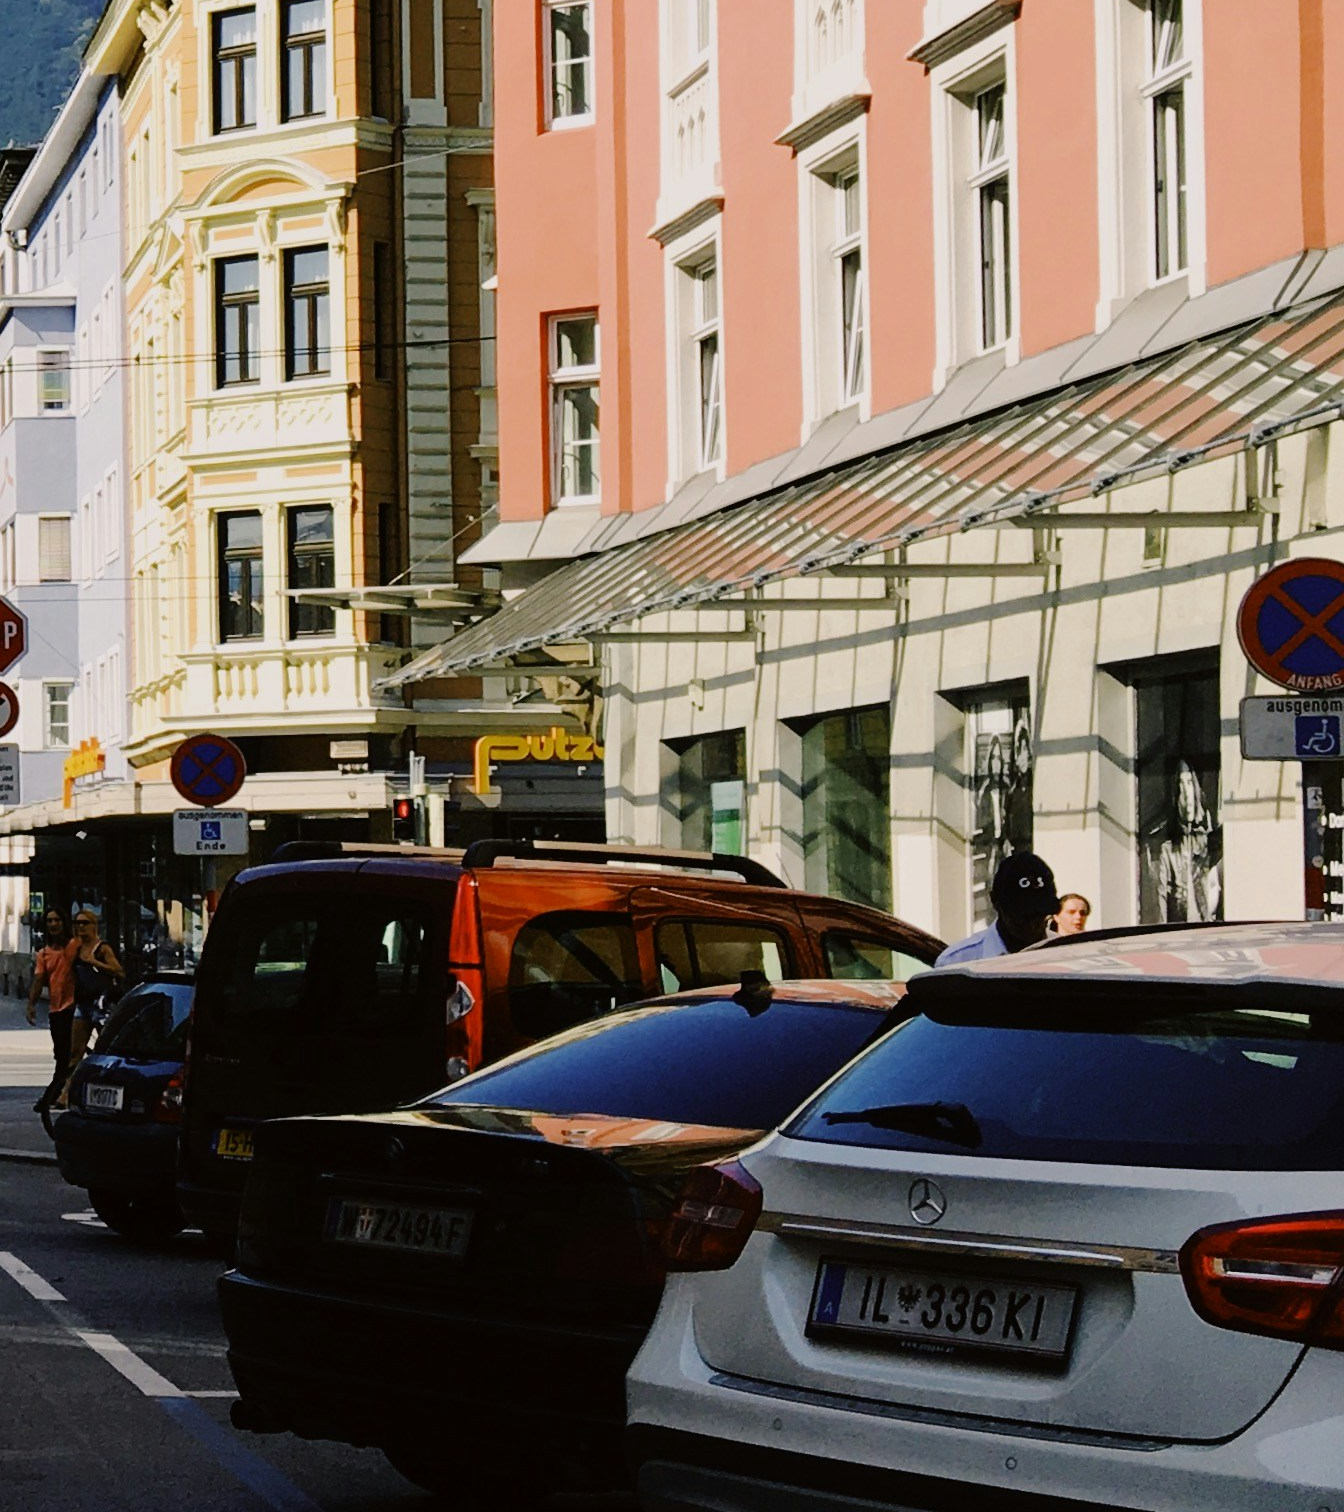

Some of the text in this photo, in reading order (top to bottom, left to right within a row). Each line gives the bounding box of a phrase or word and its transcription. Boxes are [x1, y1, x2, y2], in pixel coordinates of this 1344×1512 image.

[1286, 673, 1342, 690] ANFANG
[196, 841, 226, 850] Ende
[1018, 876, 1045, 888] GS
[859, 1275, 890, 1323] IL
